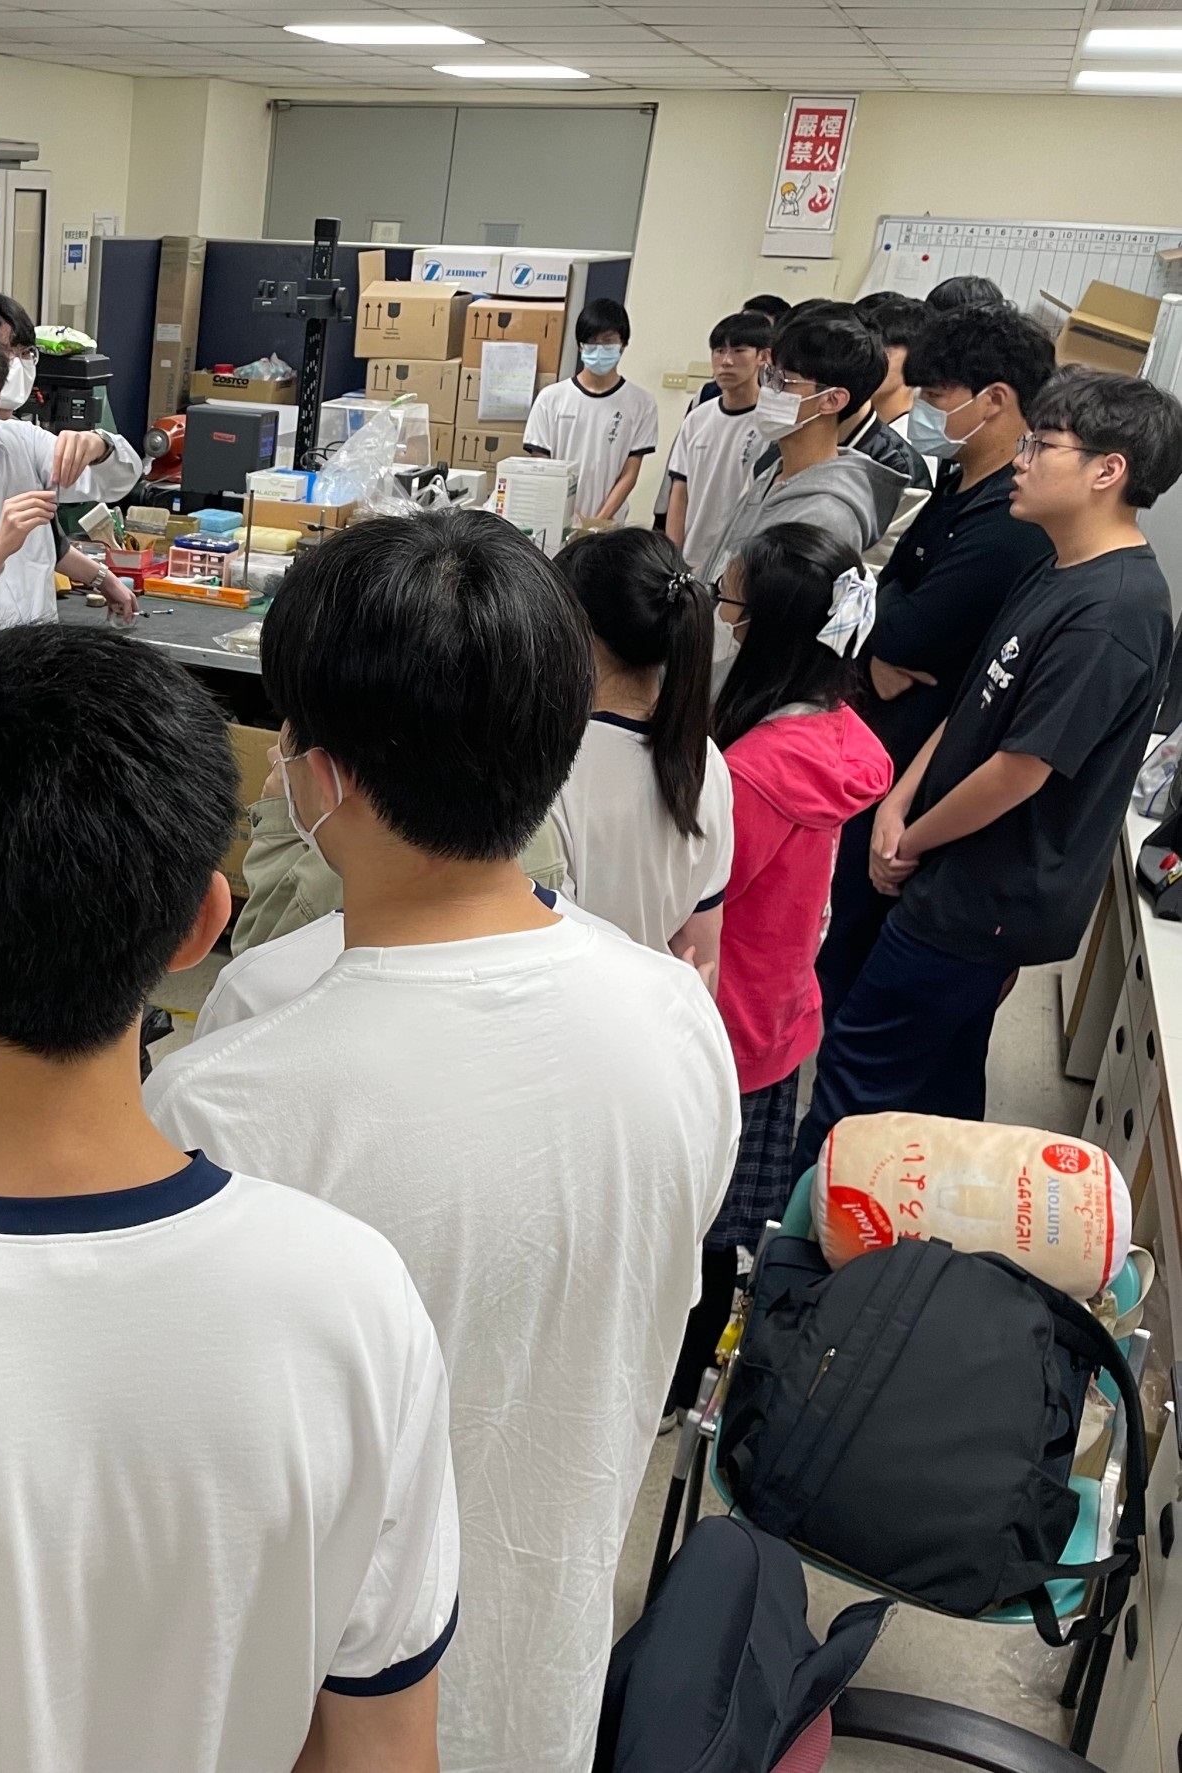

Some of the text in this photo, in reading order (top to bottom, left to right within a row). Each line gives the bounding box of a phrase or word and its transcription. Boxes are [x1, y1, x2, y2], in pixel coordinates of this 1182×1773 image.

[1111, 233, 1121, 241] 13
[1128, 234, 1137, 242] 14
[1144, 235, 1154, 243] 15
[446, 269, 487, 278] zimmer
[213, 374, 249, 385] COSTCO
[1016, 1166, 1032, 1252] ハピクルサワー
[1047, 1176, 1060, 1246] SUNTORY
[841, 1203, 882, 1249] New!
